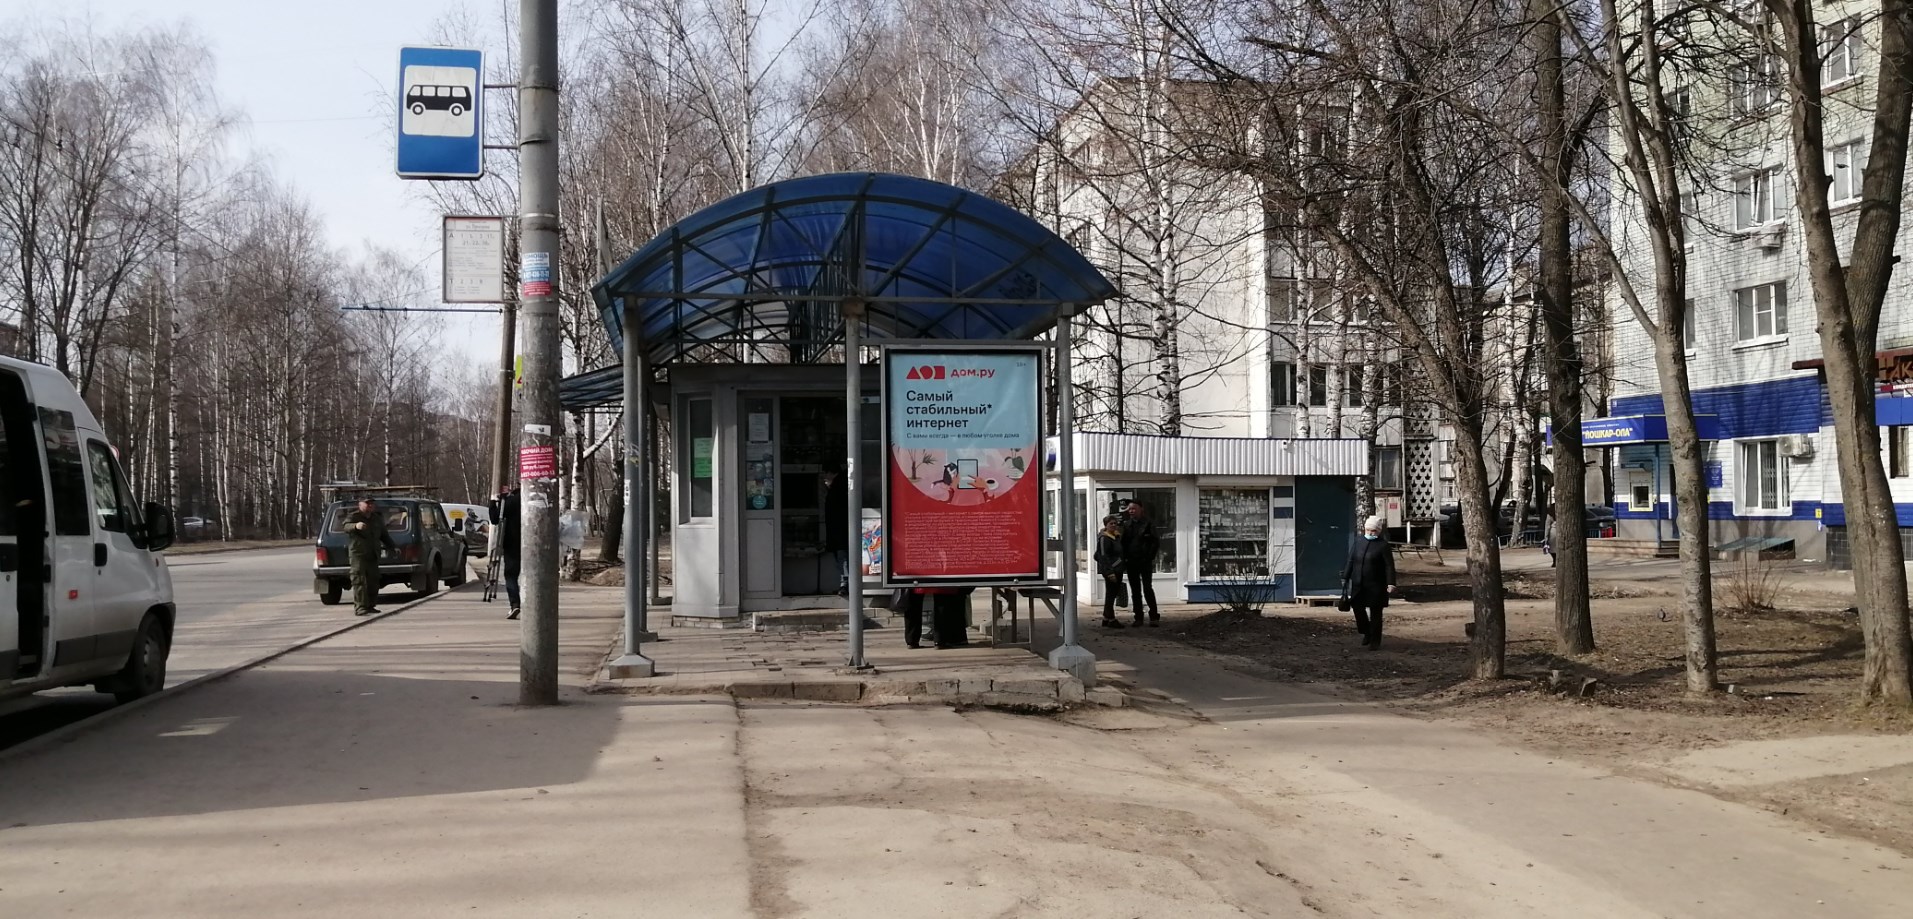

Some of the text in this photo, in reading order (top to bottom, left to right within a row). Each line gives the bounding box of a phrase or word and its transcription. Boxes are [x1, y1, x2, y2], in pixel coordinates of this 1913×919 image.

[950, 368, 996, 378] дом.ру
[906, 390, 953, 401] Самый
[906, 420, 969, 430] интернет
